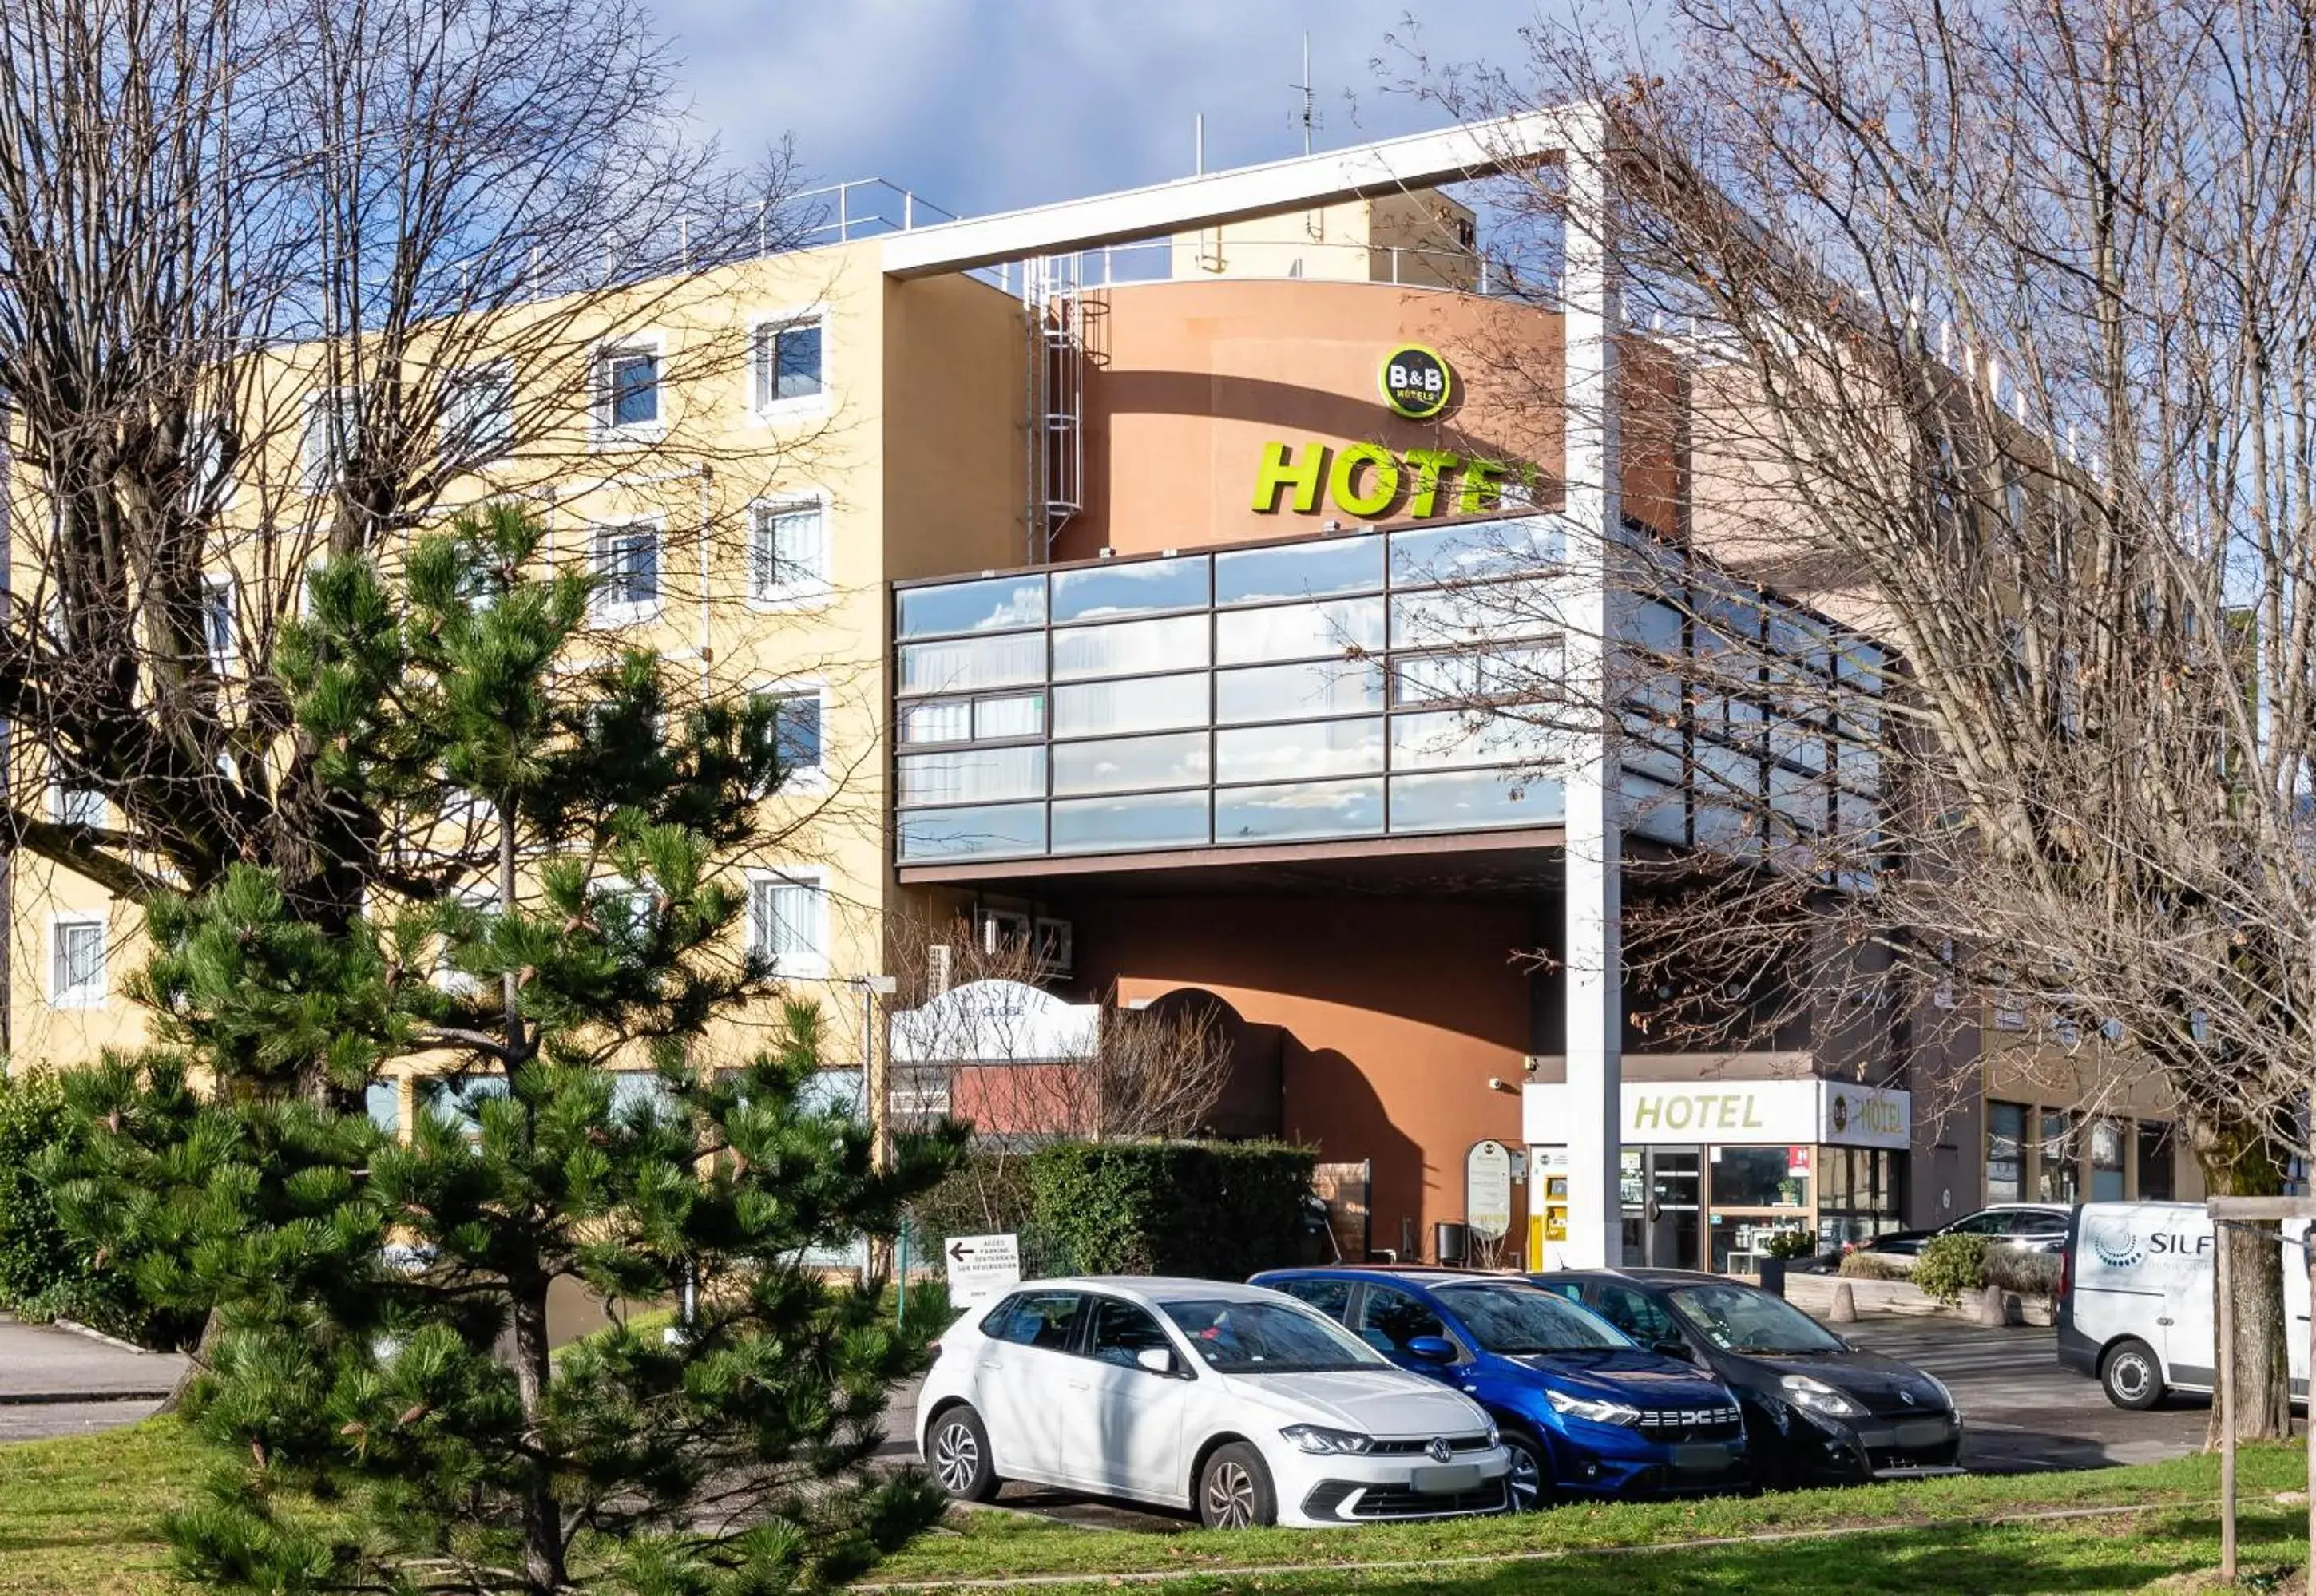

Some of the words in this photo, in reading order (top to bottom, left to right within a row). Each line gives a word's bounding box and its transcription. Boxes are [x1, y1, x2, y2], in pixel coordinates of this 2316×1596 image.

[1390, 365, 1442, 391] B&B
[1397, 389, 1434, 401] HOTELS
[1633, 1095, 1763, 1130] HOTEL
[1862, 1097, 1904, 1132] HOTEL
